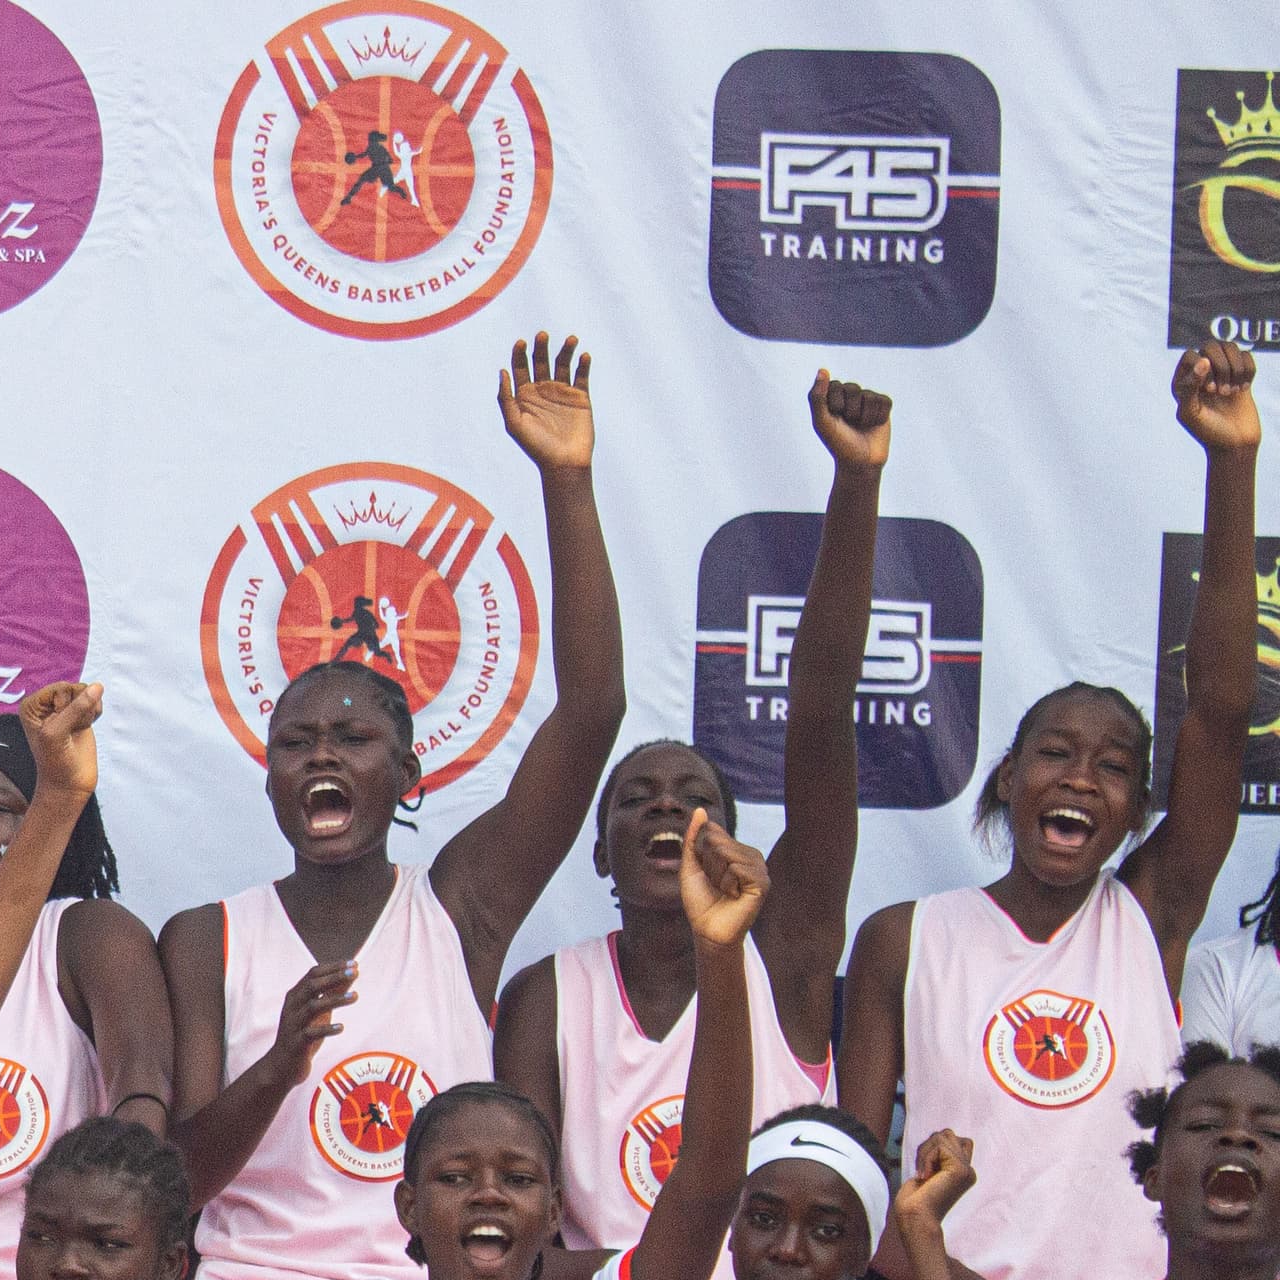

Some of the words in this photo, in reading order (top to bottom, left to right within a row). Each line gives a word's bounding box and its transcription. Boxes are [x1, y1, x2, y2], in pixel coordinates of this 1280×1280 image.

[252, 111, 278, 231] VICTORIA'S
[272, 233, 341, 295] QUEENS
[346, 257, 477, 304] BASKETBALL
[473, 117, 516, 257] FOUNDATION
[768, 142, 943, 224] F45
[14, 248, 47, 264] SPA
[760, 231, 946, 264] TRAINING
[237, 575, 265, 698] VICTORIA'S
[459, 581, 502, 720] FOUNDATION
[760, 608, 920, 682] F5
[745, 696, 932, 726] TRING
